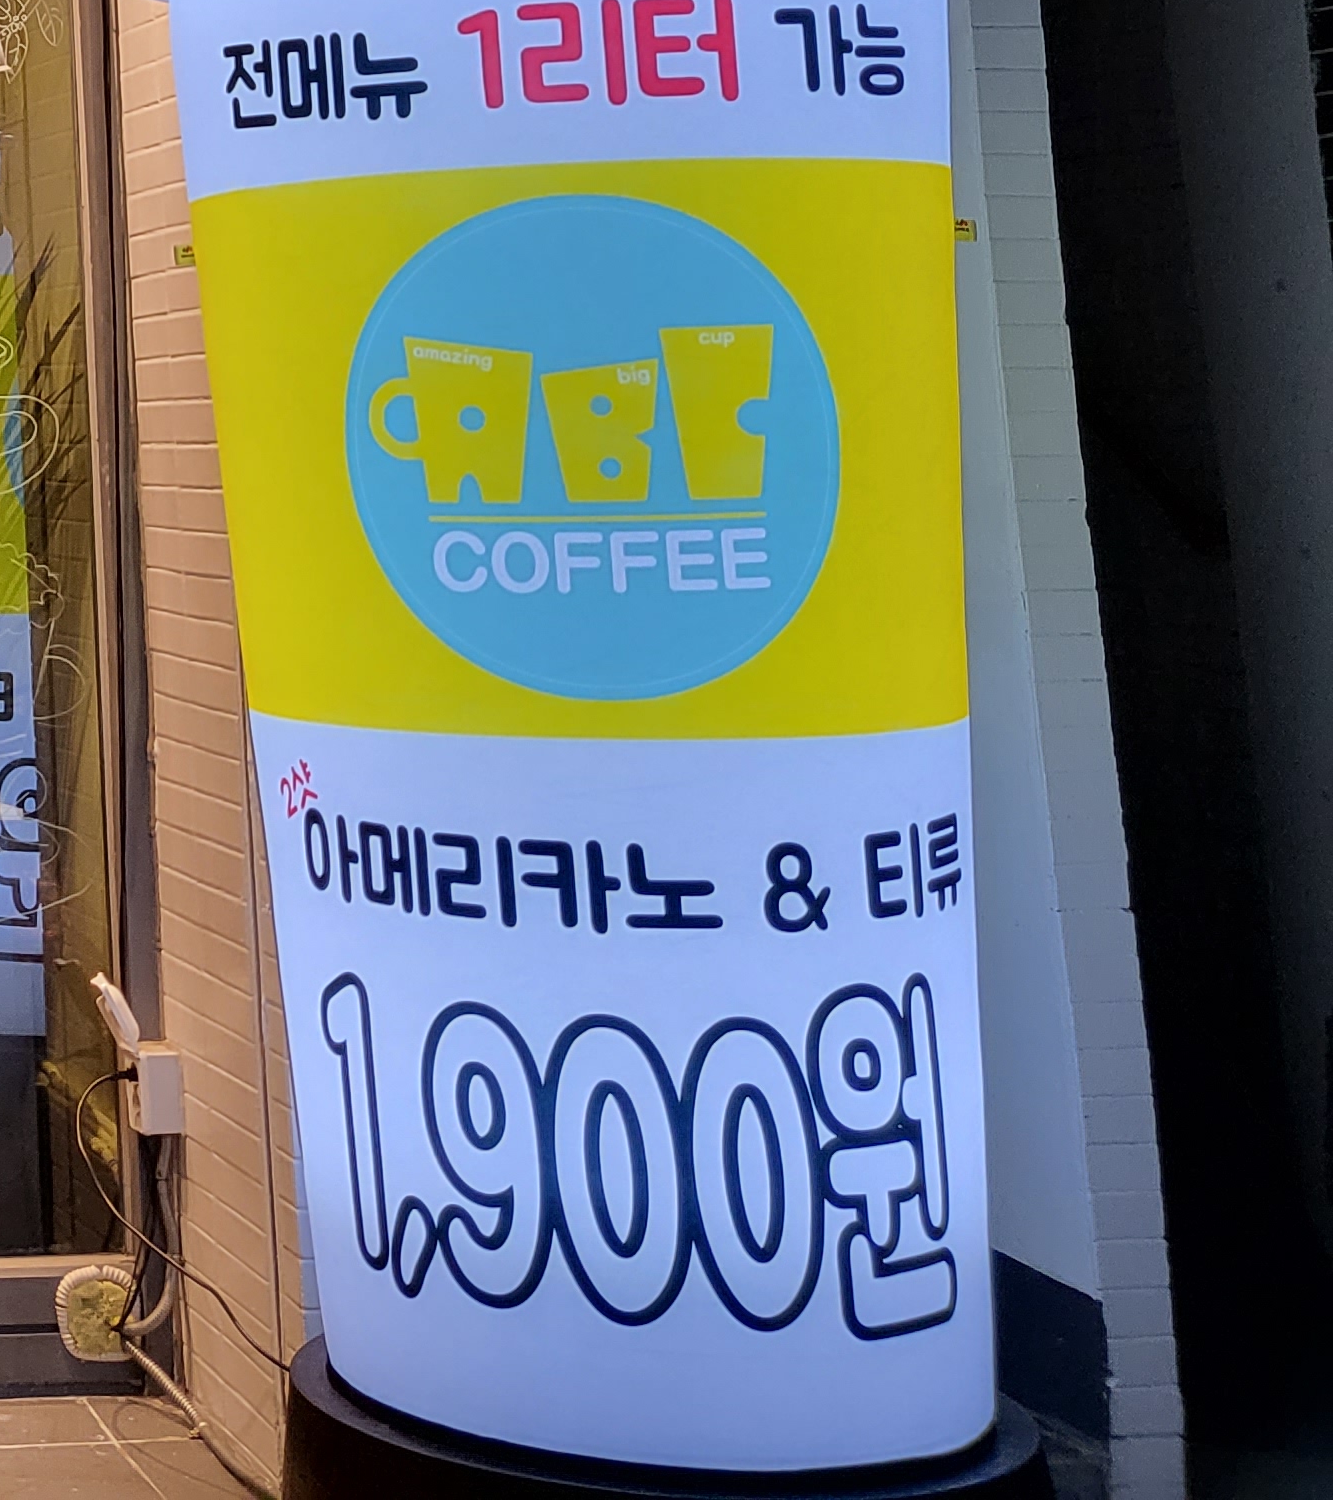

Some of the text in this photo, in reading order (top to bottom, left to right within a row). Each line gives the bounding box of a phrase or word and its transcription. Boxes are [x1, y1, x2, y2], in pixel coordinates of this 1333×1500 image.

[222, 31, 428, 130] 전메뉴
[773, 3, 907, 98] 가능
[368, 323, 774, 504] ABC
[413, 331, 735, 386] amazing big cup
[432, 527, 772, 594] COFFEE
[302, 807, 963, 935] 아메리카노 & 티류
[319, 970, 959, 1342] 1,900원
